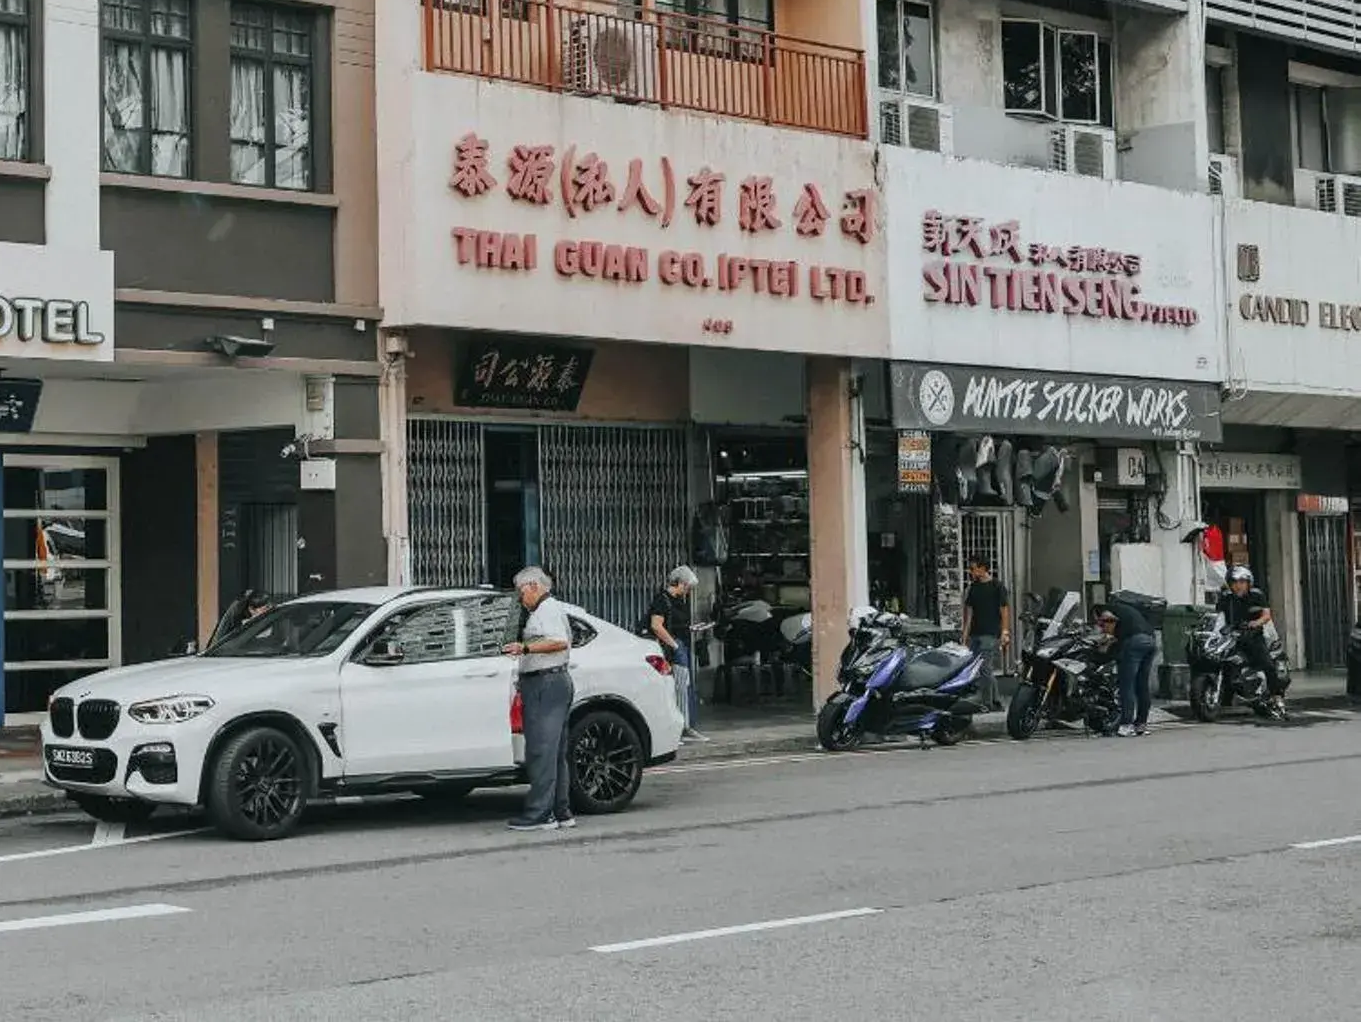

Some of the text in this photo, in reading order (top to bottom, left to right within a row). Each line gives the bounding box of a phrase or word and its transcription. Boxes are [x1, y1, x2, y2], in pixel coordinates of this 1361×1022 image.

[449, 131, 879, 245] 泰源(私人)有限公司
[451, 226, 537, 271] THAI
[555, 240, 649, 283] GUAN
[658, 248, 713, 288] CO.
[809, 264, 876, 305] LTD.
[923, 261, 980, 306] SIN
[983, 265, 1061, 315] TIEN
[1060, 276, 1144, 321] SENG
[1239, 293, 1309, 328] CANDID
[1038, 380, 1123, 423] STICKER
[1127, 387, 1189, 426] WORKS
